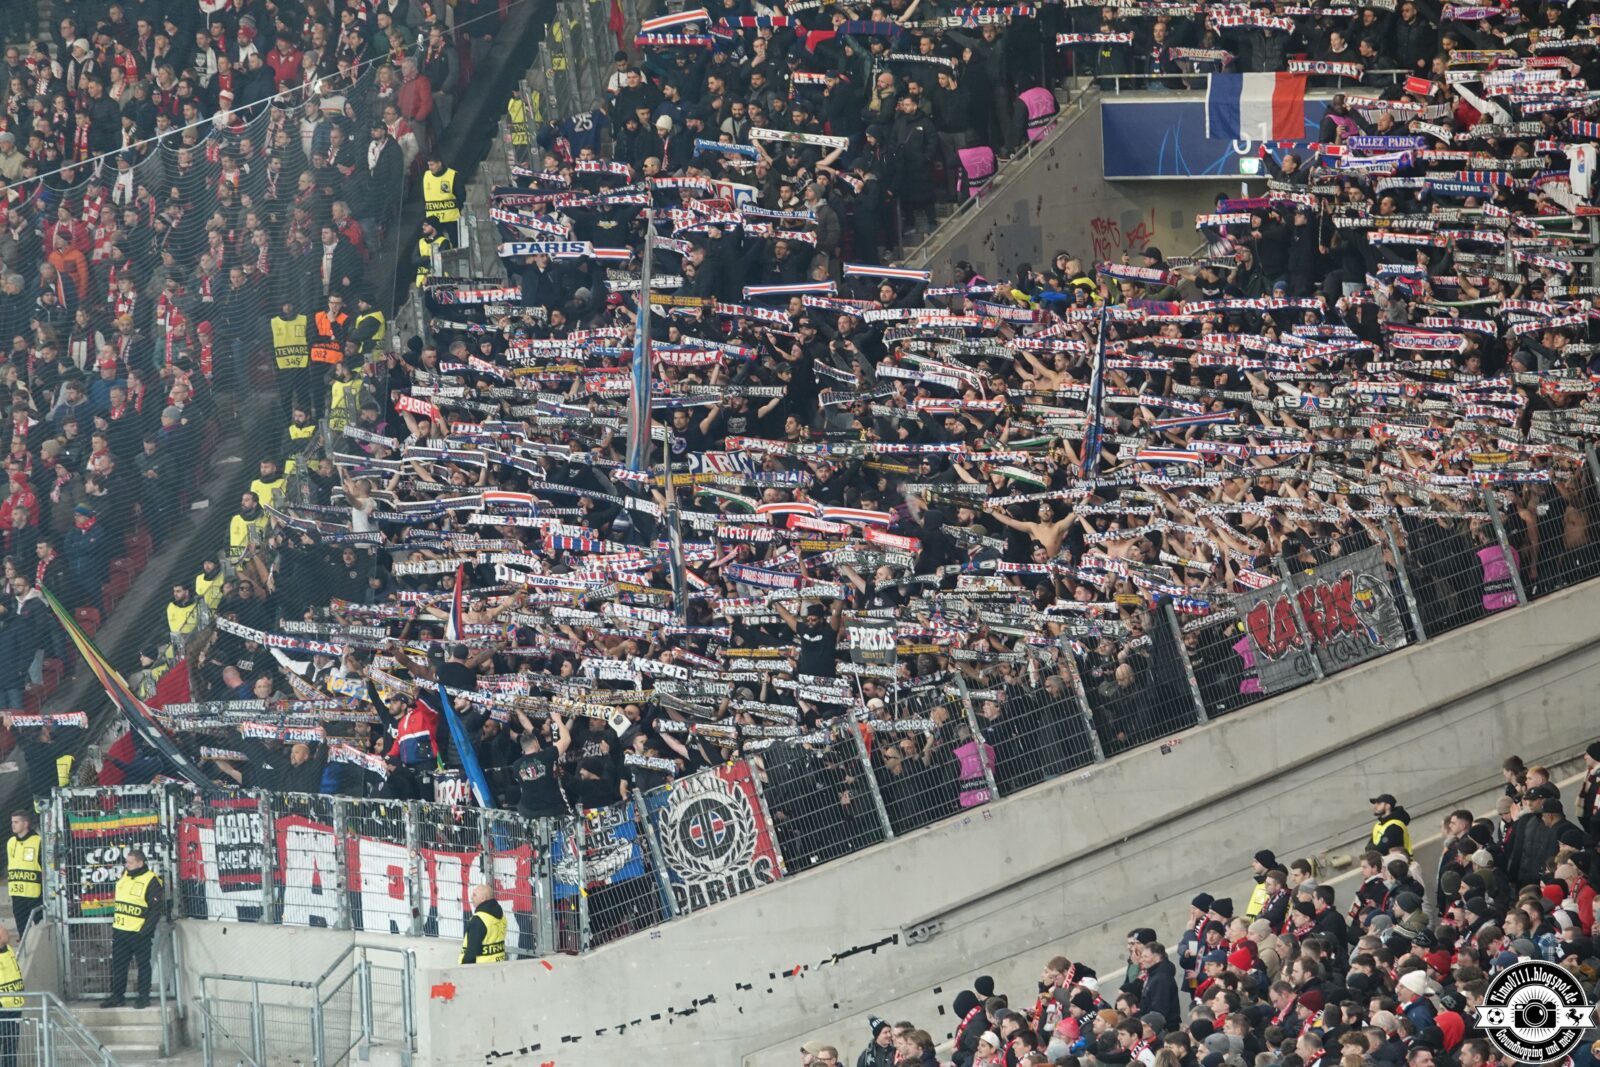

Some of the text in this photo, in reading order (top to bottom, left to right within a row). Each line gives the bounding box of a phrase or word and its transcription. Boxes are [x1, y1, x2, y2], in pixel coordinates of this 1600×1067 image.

[647, 33, 691, 45] PARIS
[1093, 32, 1130, 43] RAS
[1290, 60, 1310, 72] ULT
[1485, 73, 1515, 86] VIRAGE
[1357, 136, 1416, 148] ALLEZ PARIS
[1433, 183, 1481, 193] ICI C'EST PARIS
[533, 218, 569, 236] RAS
[1335, 217, 1434, 230] VIRAGE AUTEUIL
[512, 243, 585, 253] PARIS
[459, 289, 520, 302] ULTRAS
[1184, 301, 1214, 315] ULT
[1227, 299, 1266, 309] RAS
[864, 309, 902, 323] VIRAGE
[1113, 309, 1143, 320] RAS
[1016, 338, 1086, 351] ULT RAS
[507, 348, 531, 360] ULT
[1368, 359, 1450, 373] ULT RAS
[605, 380, 632, 389] PAR
[750, 386, 784, 396] AUTEUIL
[399, 396, 433, 416] PARIS
[876, 443, 960, 453] ULT RAS
[688, 451, 756, 470] PARIS
[540, 483, 625, 504] COMBAT CONTINUE
[550, 525, 581, 536] PARIS
[716, 527, 727, 537] ICI
[751, 528, 775, 541] PARIS
[530, 576, 559, 585] VIRAGE
[741, 569, 795, 587] PARIS SAINT-GERMAIN
[639, 608, 670, 624] TOUR
[1010, 604, 1032, 615] AUTE
[284, 621, 385, 638] VIRAGE AUTEUIL
[267, 636, 343, 655] ULT RAS
[164, 704, 200, 715] VIRAGE
[229, 702, 265, 710] AUTEUIL
[293, 701, 338, 710] PARIS
[585, 827, 617, 850] ARC
[482, 942, 505, 955] STEW
